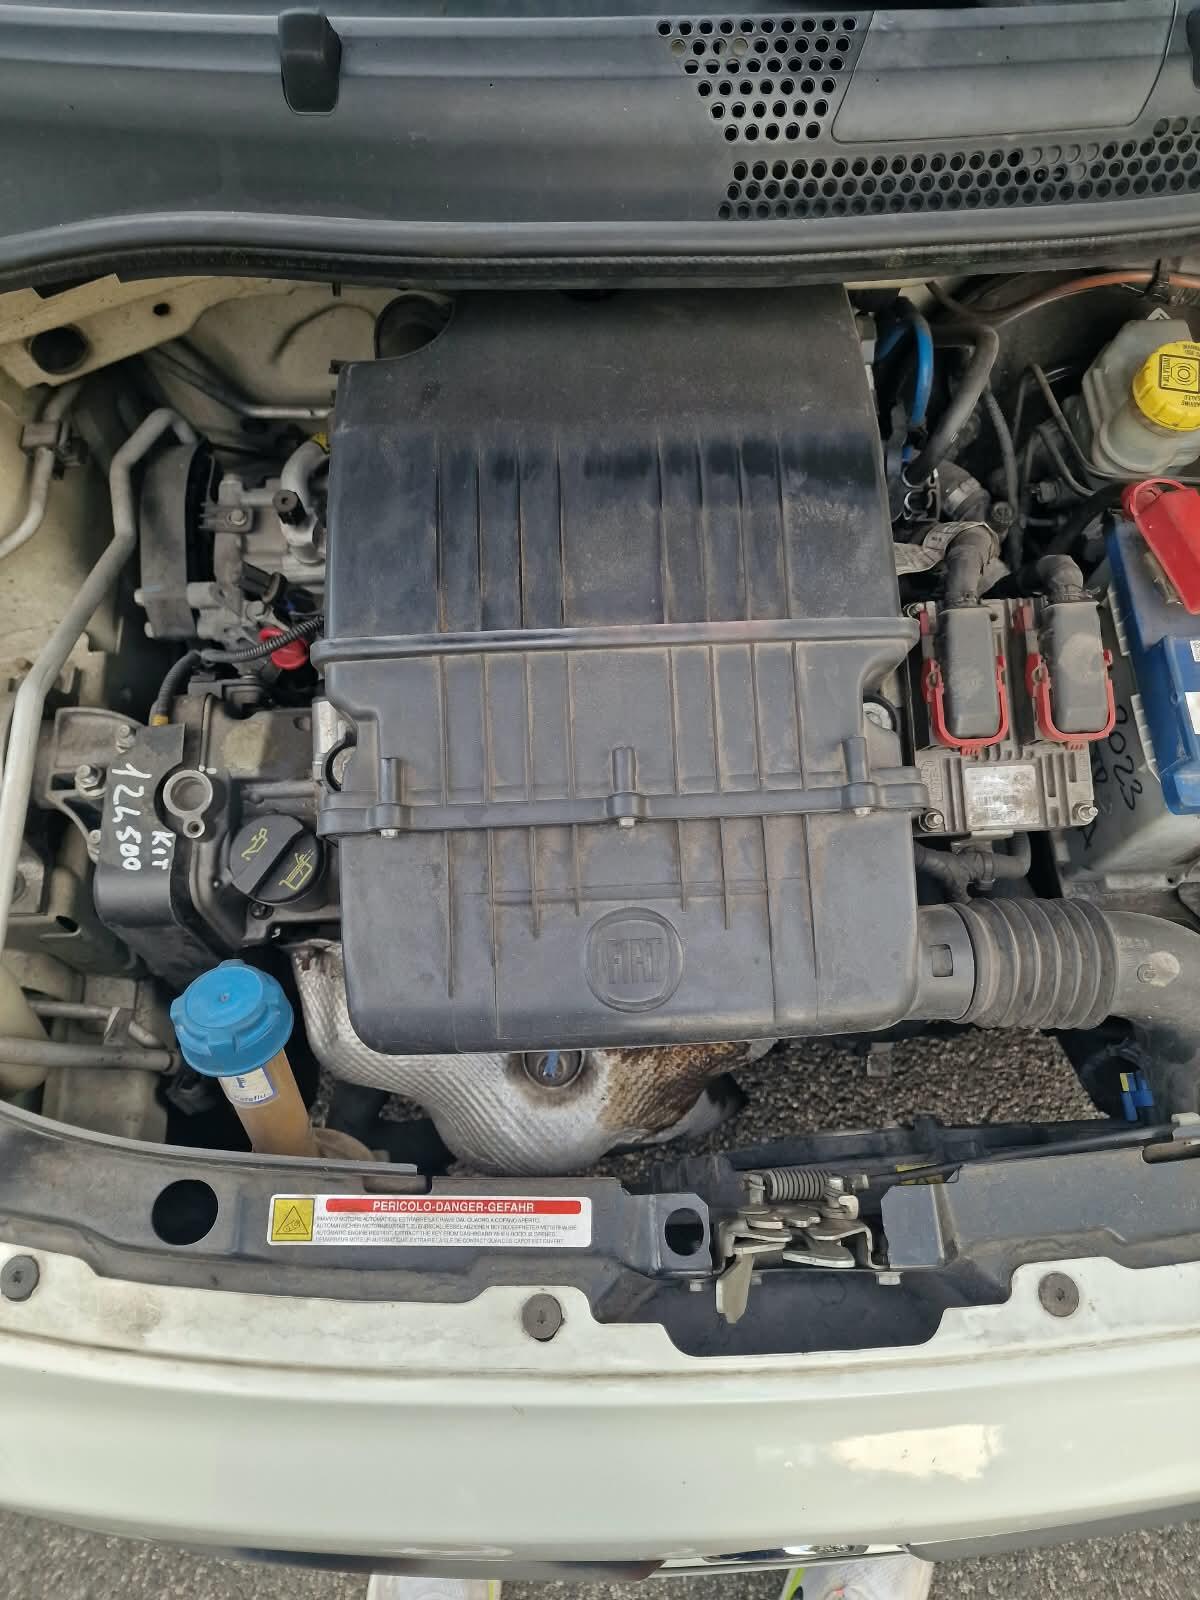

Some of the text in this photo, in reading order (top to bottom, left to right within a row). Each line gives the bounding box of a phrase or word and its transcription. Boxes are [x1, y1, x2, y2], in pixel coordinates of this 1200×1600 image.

[111, 762, 153, 871] 124500
[151, 830, 175, 871] KIT
[606, 937, 663, 985] FIAT
[372, 1200, 535, 1212] PERICOLO-DANGER-GEFAHR
